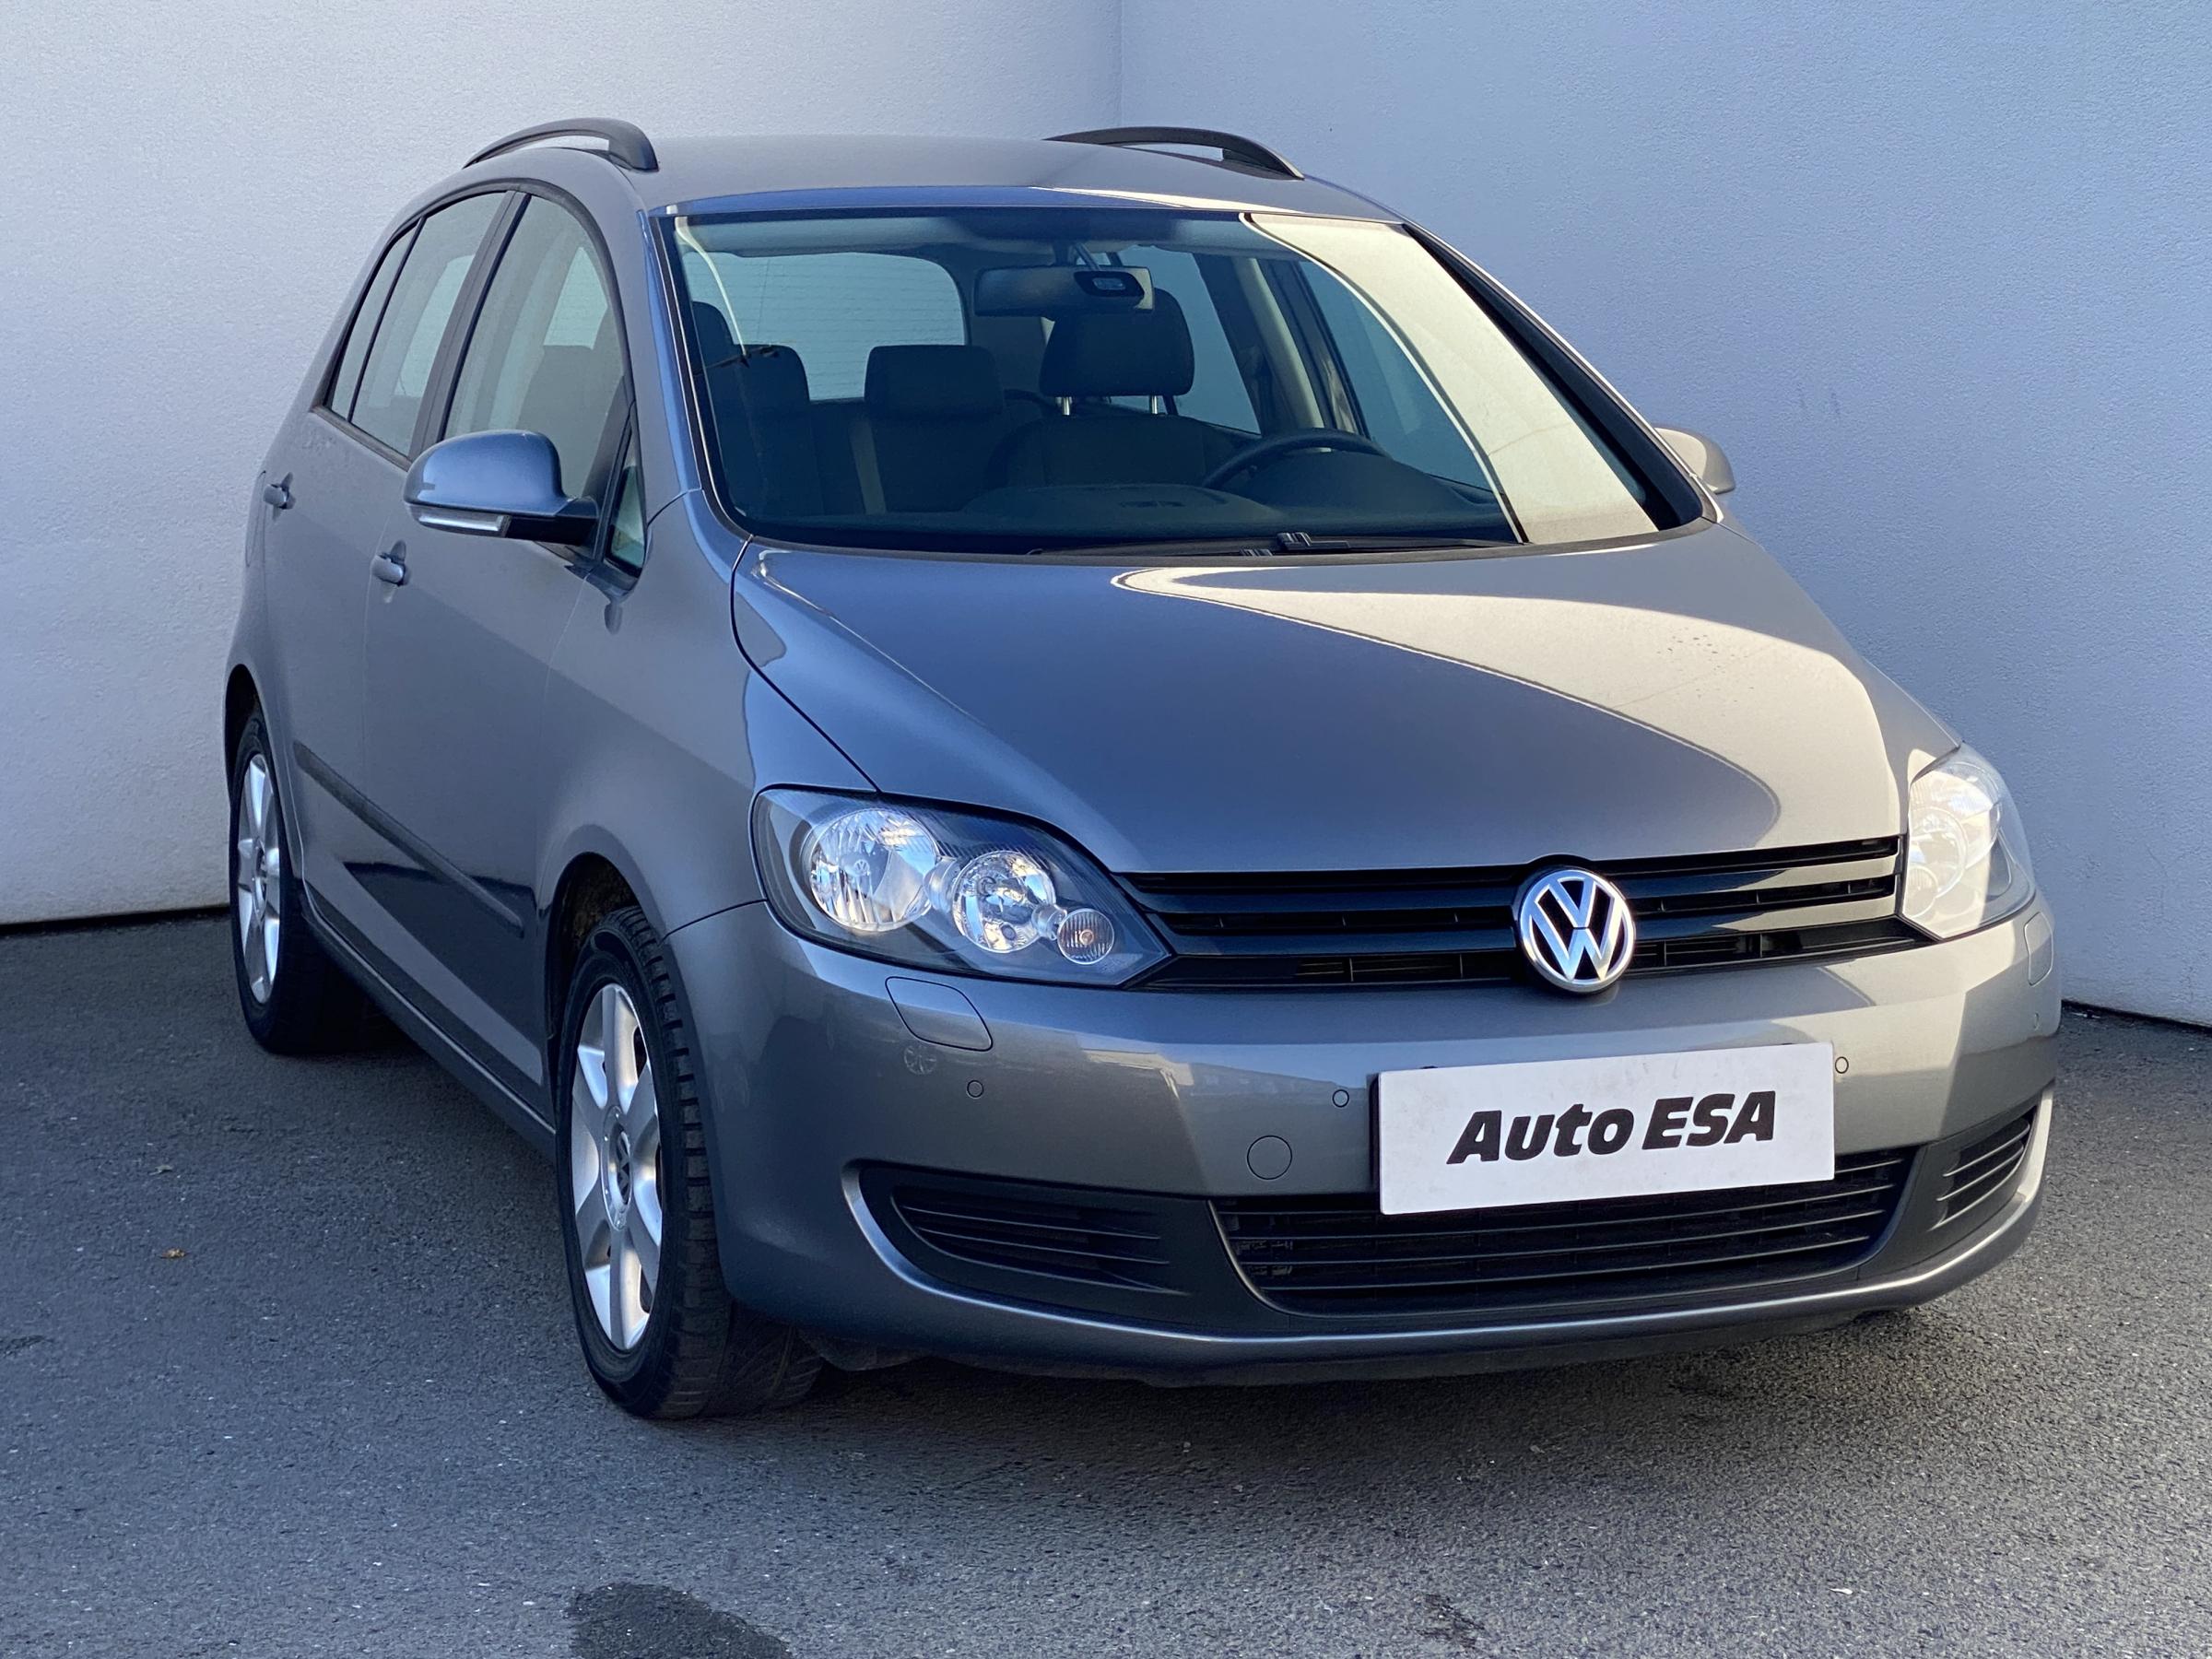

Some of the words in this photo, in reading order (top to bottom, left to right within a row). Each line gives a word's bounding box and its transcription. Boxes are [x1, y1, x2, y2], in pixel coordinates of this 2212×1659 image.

[1522, 871, 1633, 990] VW
[1446, 1104, 1634, 1164] Auto
[1642, 1090, 1776, 1150] ESA
